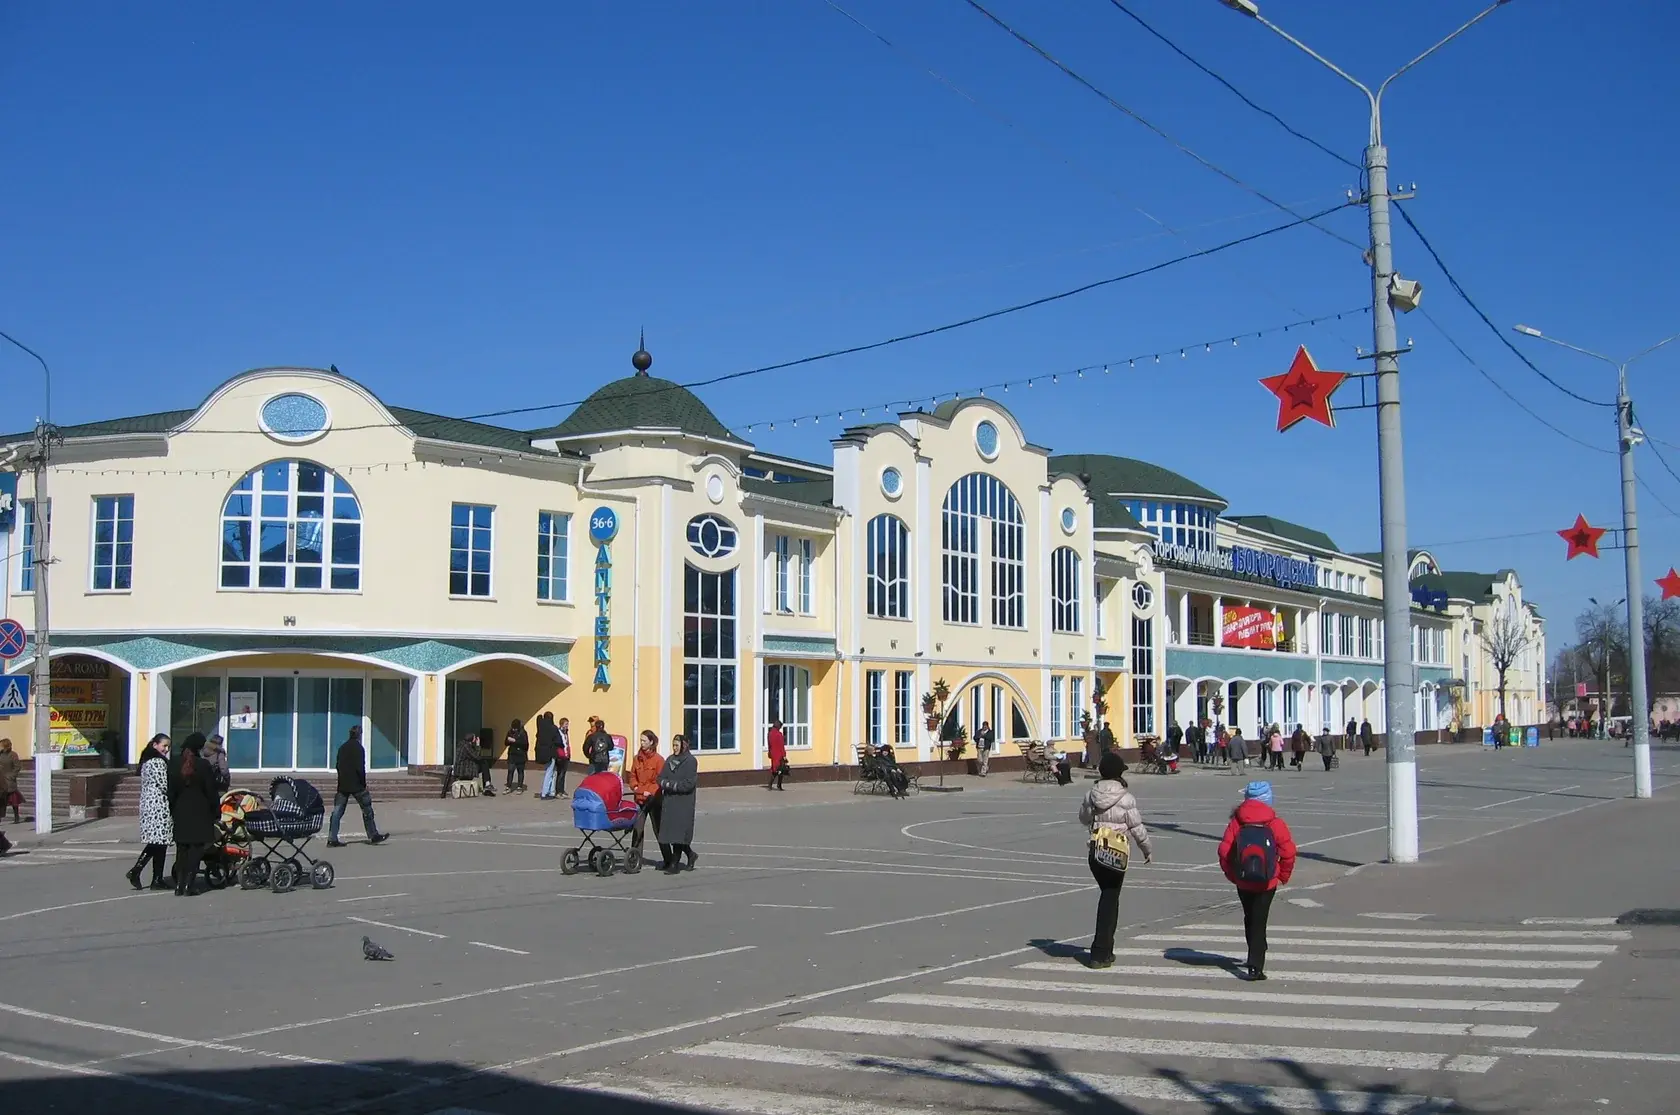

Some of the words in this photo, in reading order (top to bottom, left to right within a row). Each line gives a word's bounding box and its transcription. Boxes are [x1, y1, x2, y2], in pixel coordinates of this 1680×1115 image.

[1235, 545, 1317, 588] БОГОРОДСКИЙ
[594, 544, 610, 685] АПТЕКА
[75, 663, 105, 674] ROMA
[84, 710, 106, 722] ТУРЫ
